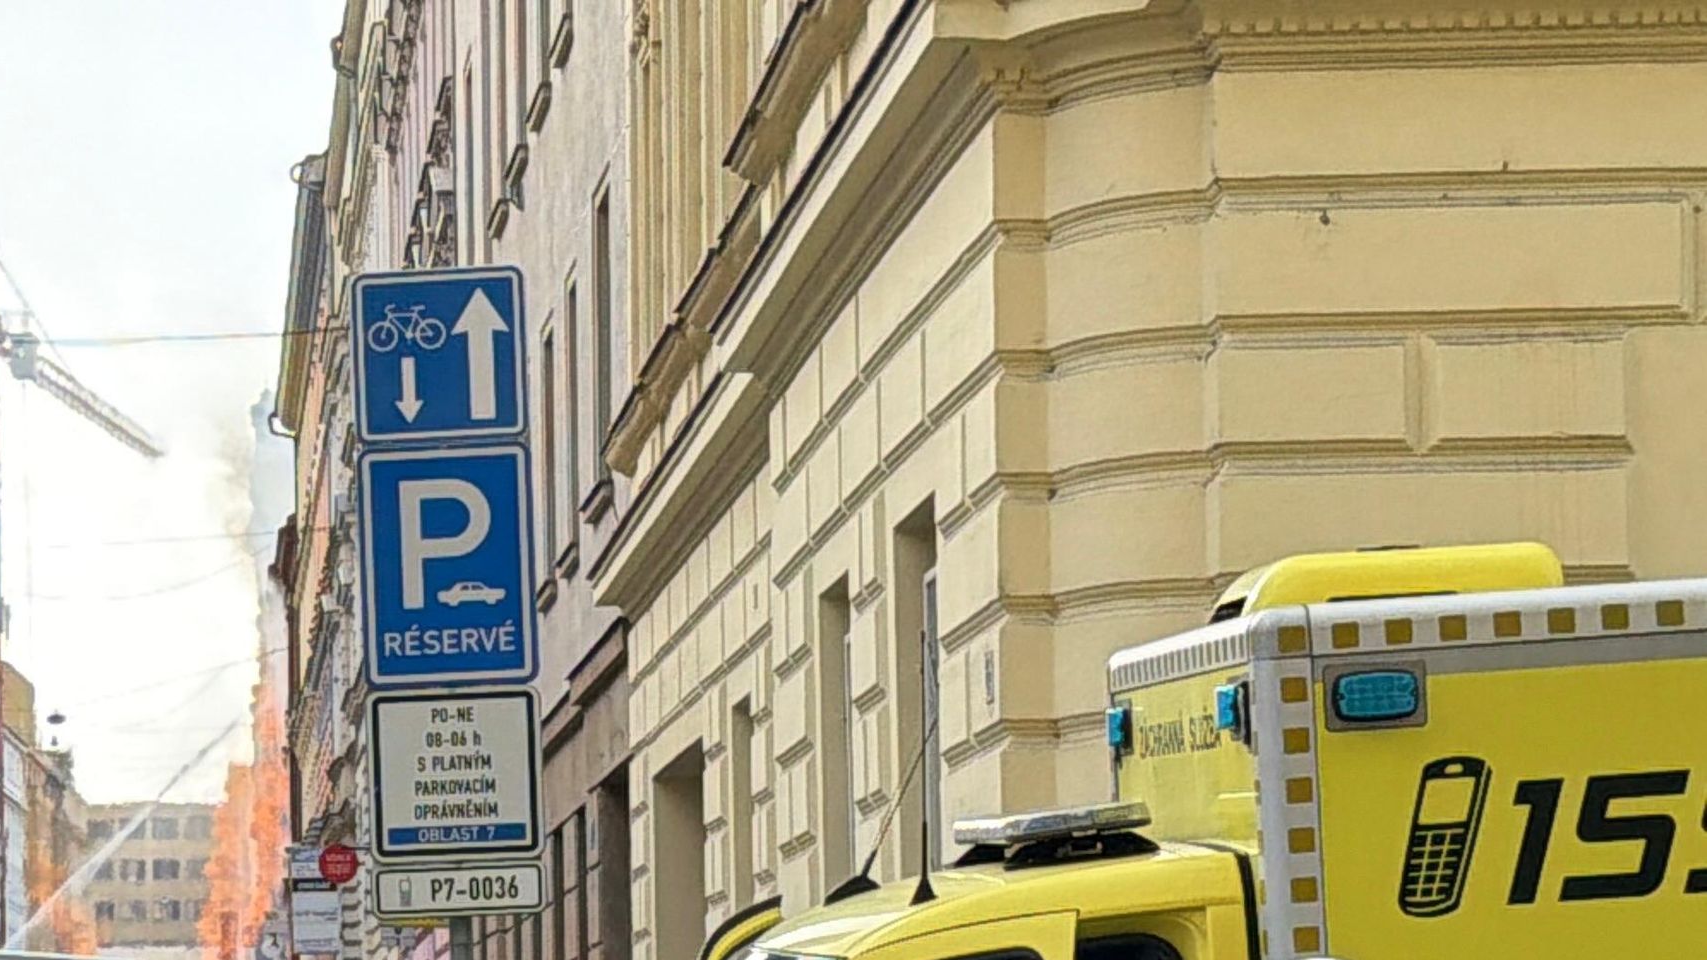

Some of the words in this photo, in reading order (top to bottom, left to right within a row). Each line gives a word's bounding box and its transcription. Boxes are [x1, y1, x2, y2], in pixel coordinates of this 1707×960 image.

[398, 478, 492, 610] P
[383, 619, 516, 657] RÉSERVÉ
[431, 706, 474, 724] PO-NE
[426, 731, 467, 748] 08-06
[473, 730, 482, 746] h
[417, 757, 426, 772] S
[432, 750, 492, 772] PLATNÝM
[414, 775, 496, 796] PARKOVACÍM
[414, 798, 499, 820] OPRÁVNĚNÍM
[418, 826, 478, 842] OBLAST
[487, 825, 496, 841] 7
[1506, 769, 1707, 906] 15
[430, 874, 519, 902] P7-0036
